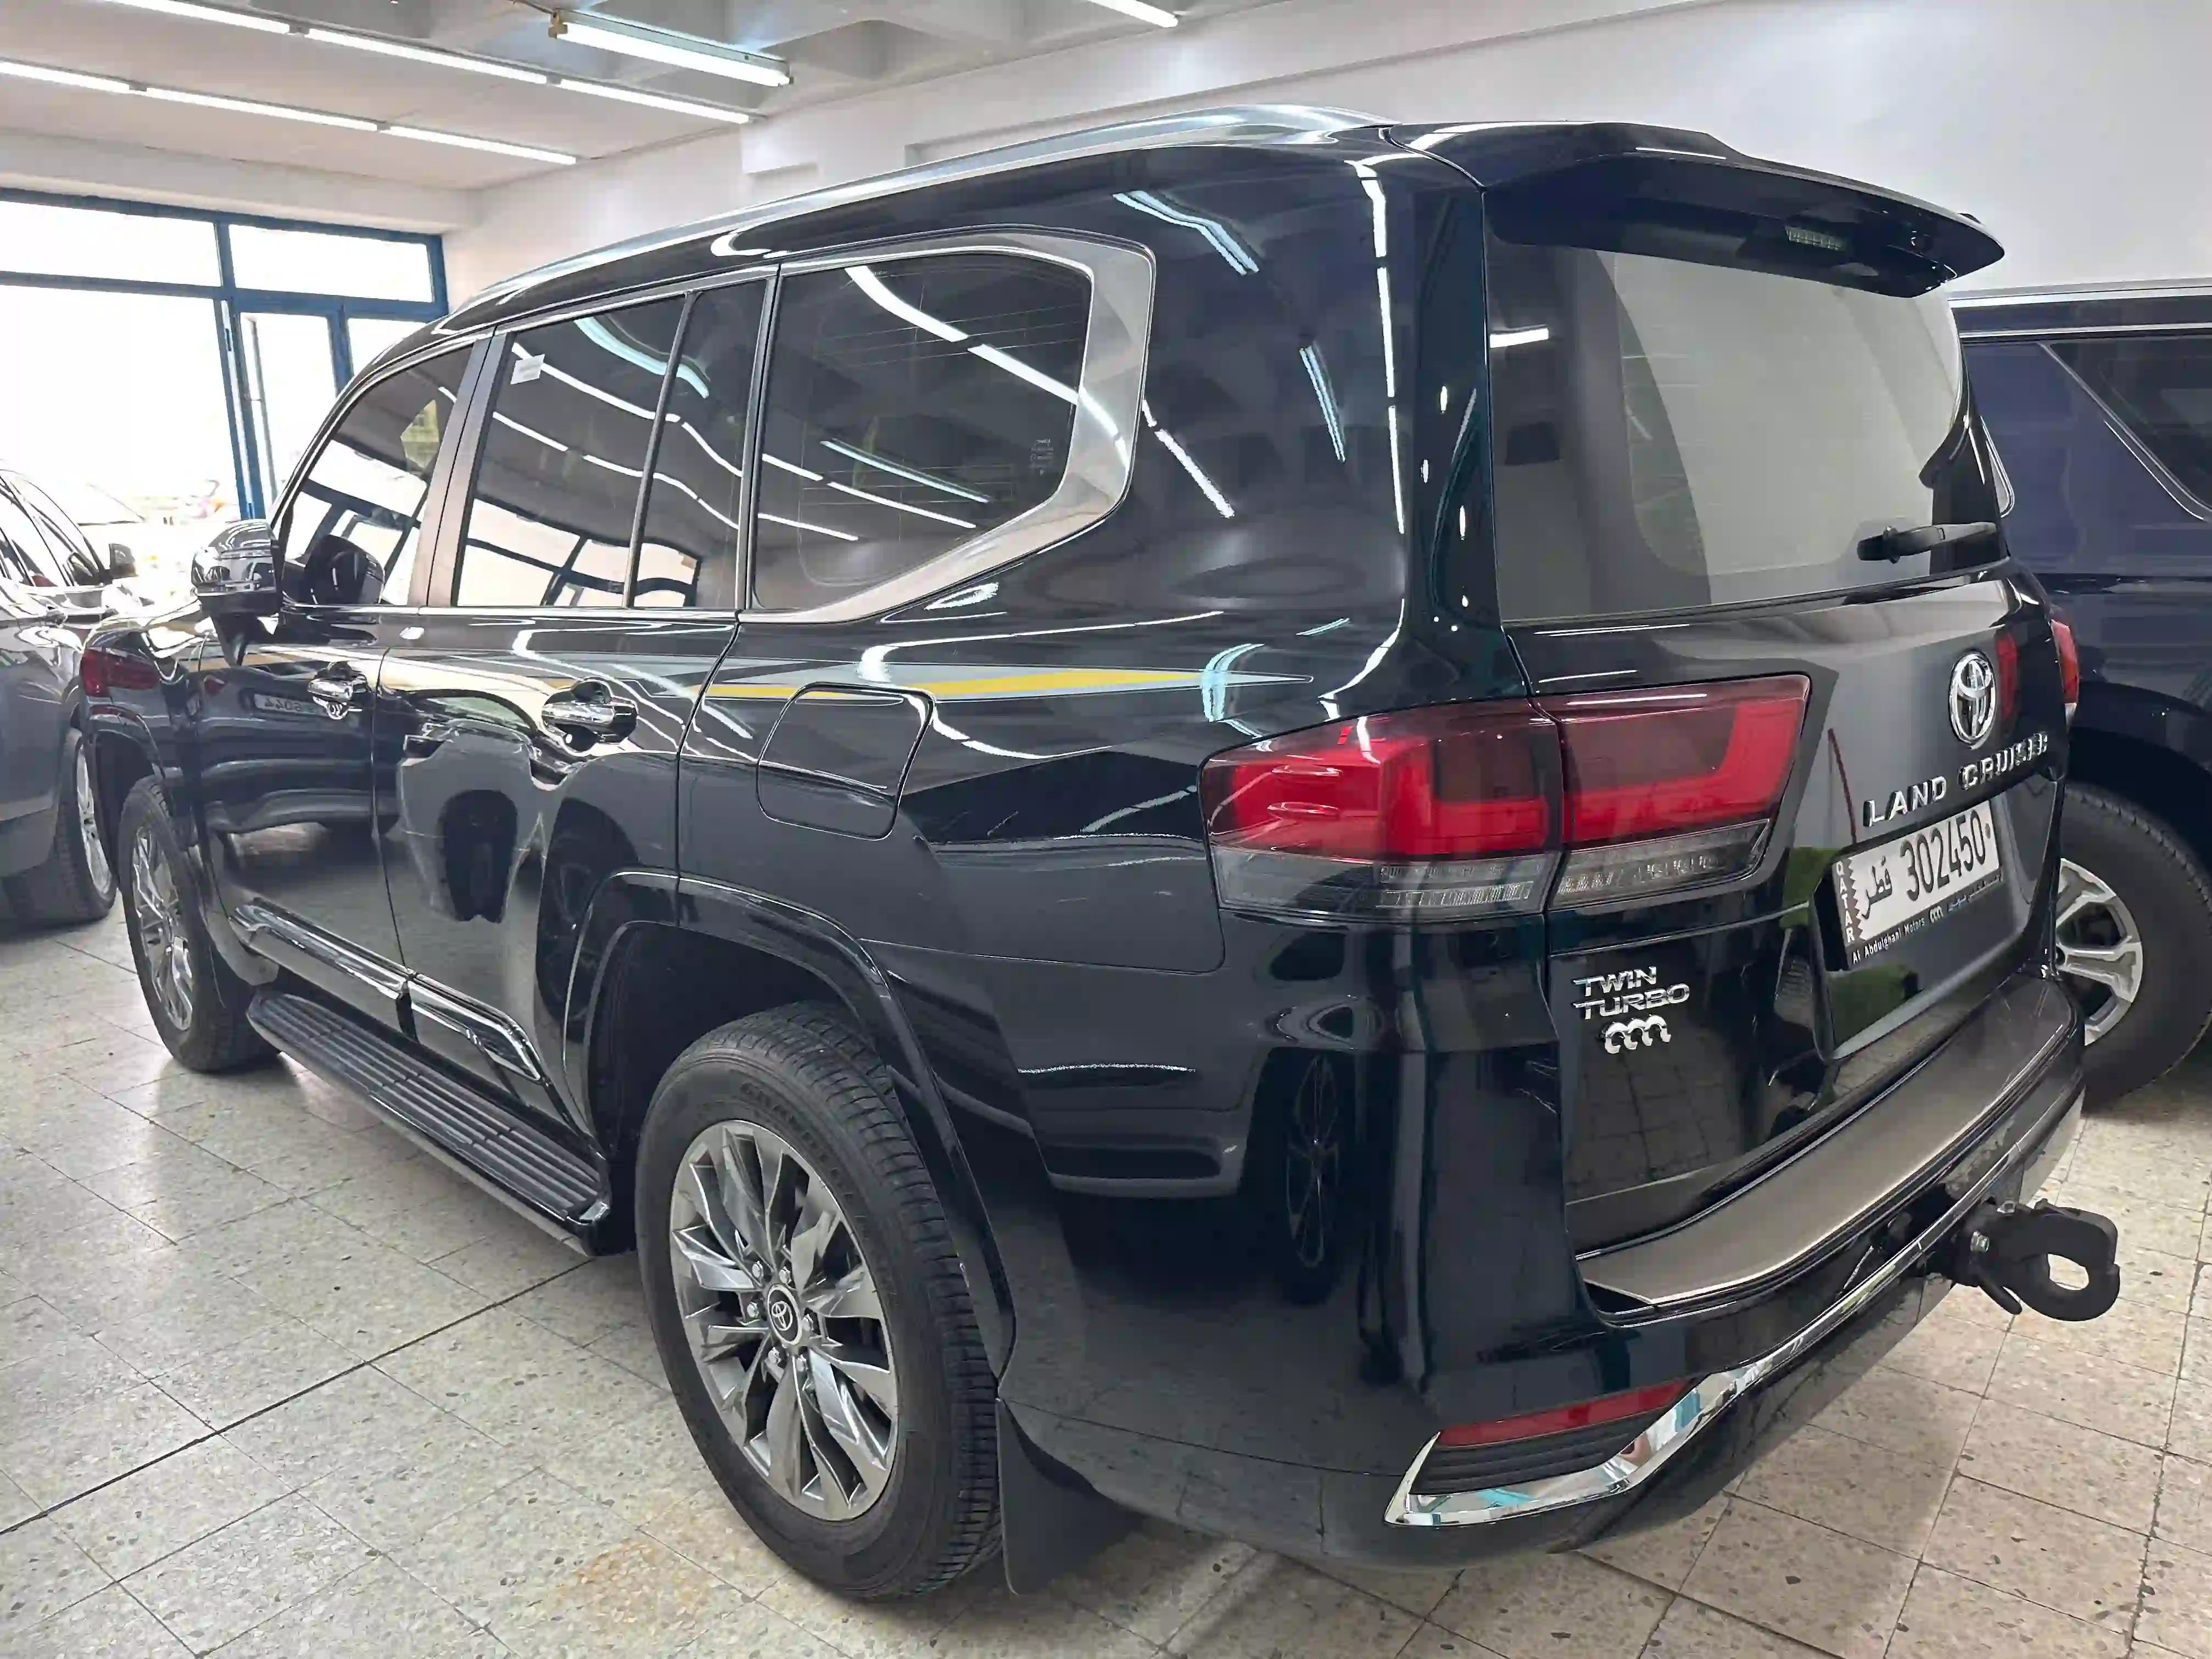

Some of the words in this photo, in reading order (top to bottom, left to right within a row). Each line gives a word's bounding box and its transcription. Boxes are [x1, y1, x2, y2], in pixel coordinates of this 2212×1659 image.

[1863, 775, 1947, 827] LAND
[1900, 810, 1986, 901] 302450
[1836, 861, 1855, 943] QATAR
[1862, 855, 1893, 919] قطر
[1864, 927, 1901, 958] Abdulghani
[1904, 918, 1925, 936] Motors
[1572, 966, 1657, 997] TWIN
[1572, 983, 1690, 1020] TURBO
